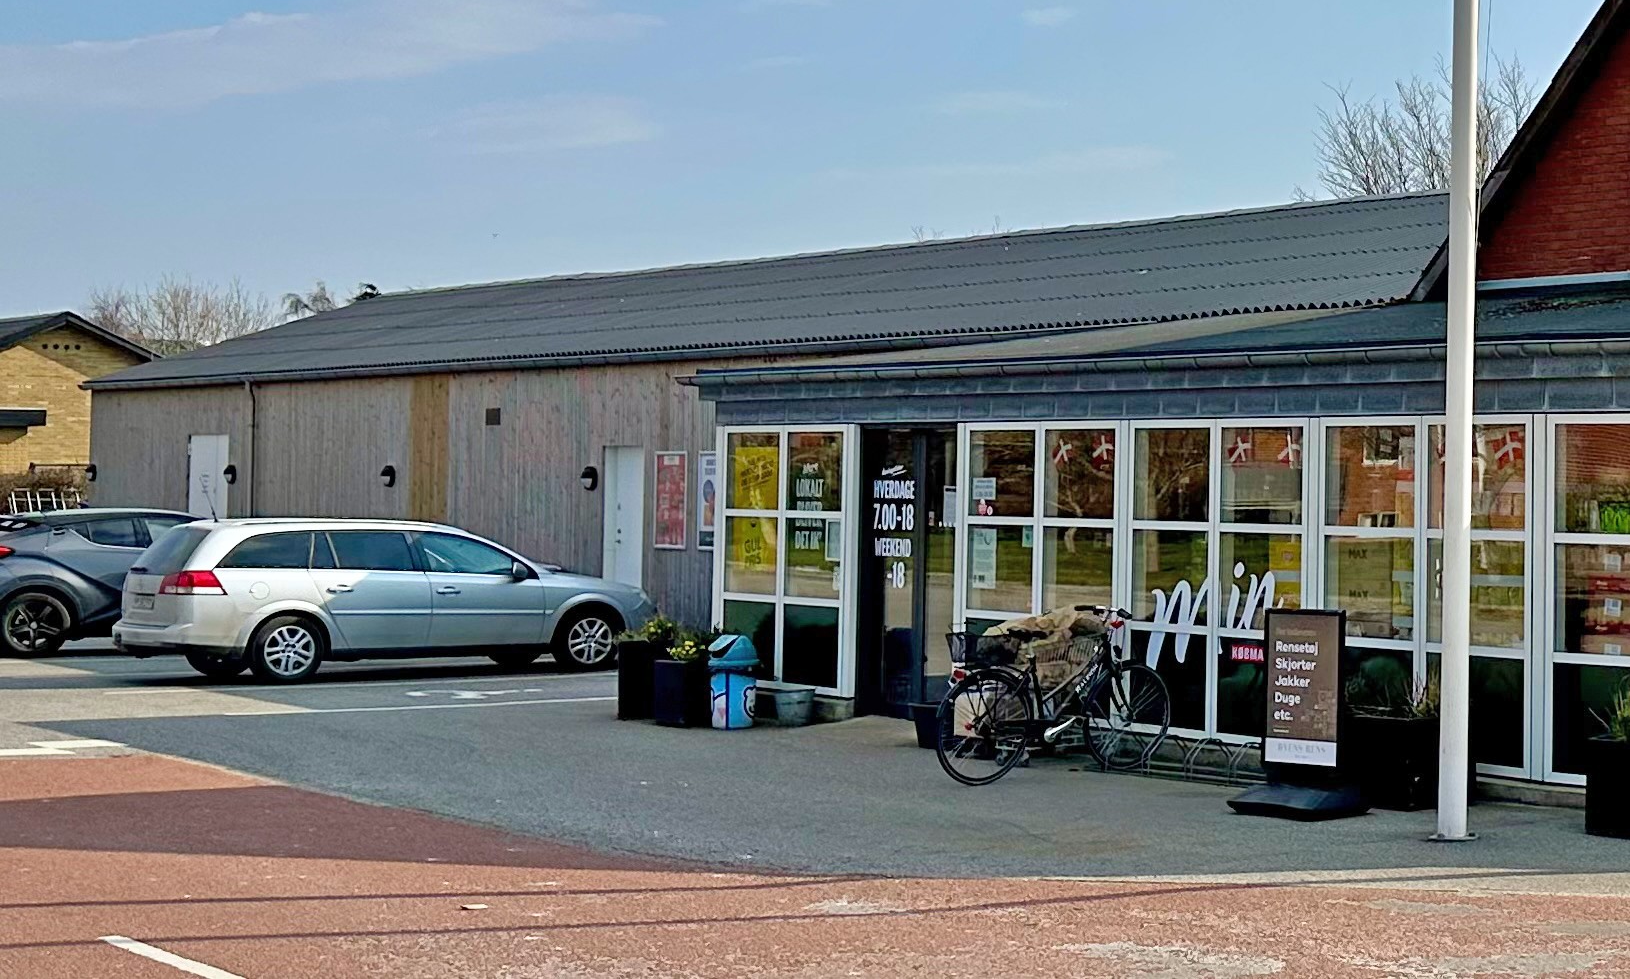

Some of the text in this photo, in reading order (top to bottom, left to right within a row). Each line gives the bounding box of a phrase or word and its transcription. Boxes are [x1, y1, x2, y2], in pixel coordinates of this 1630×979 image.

[796, 478, 824, 498] LOKALT
[873, 480, 915, 499] HVERDAGE
[873, 503, 914, 530] 7.00-18
[875, 537, 912, 557] WEEKEND
[1231, 645, 1264, 661] KØBMA
[1275, 641, 1319, 656] Rensetøj
[1275, 657, 1316, 671] Skjorter
[1274, 674, 1310, 688] Jakker
[1274, 692, 1301, 706] Duge
[1273, 710, 1293, 721] etc.
